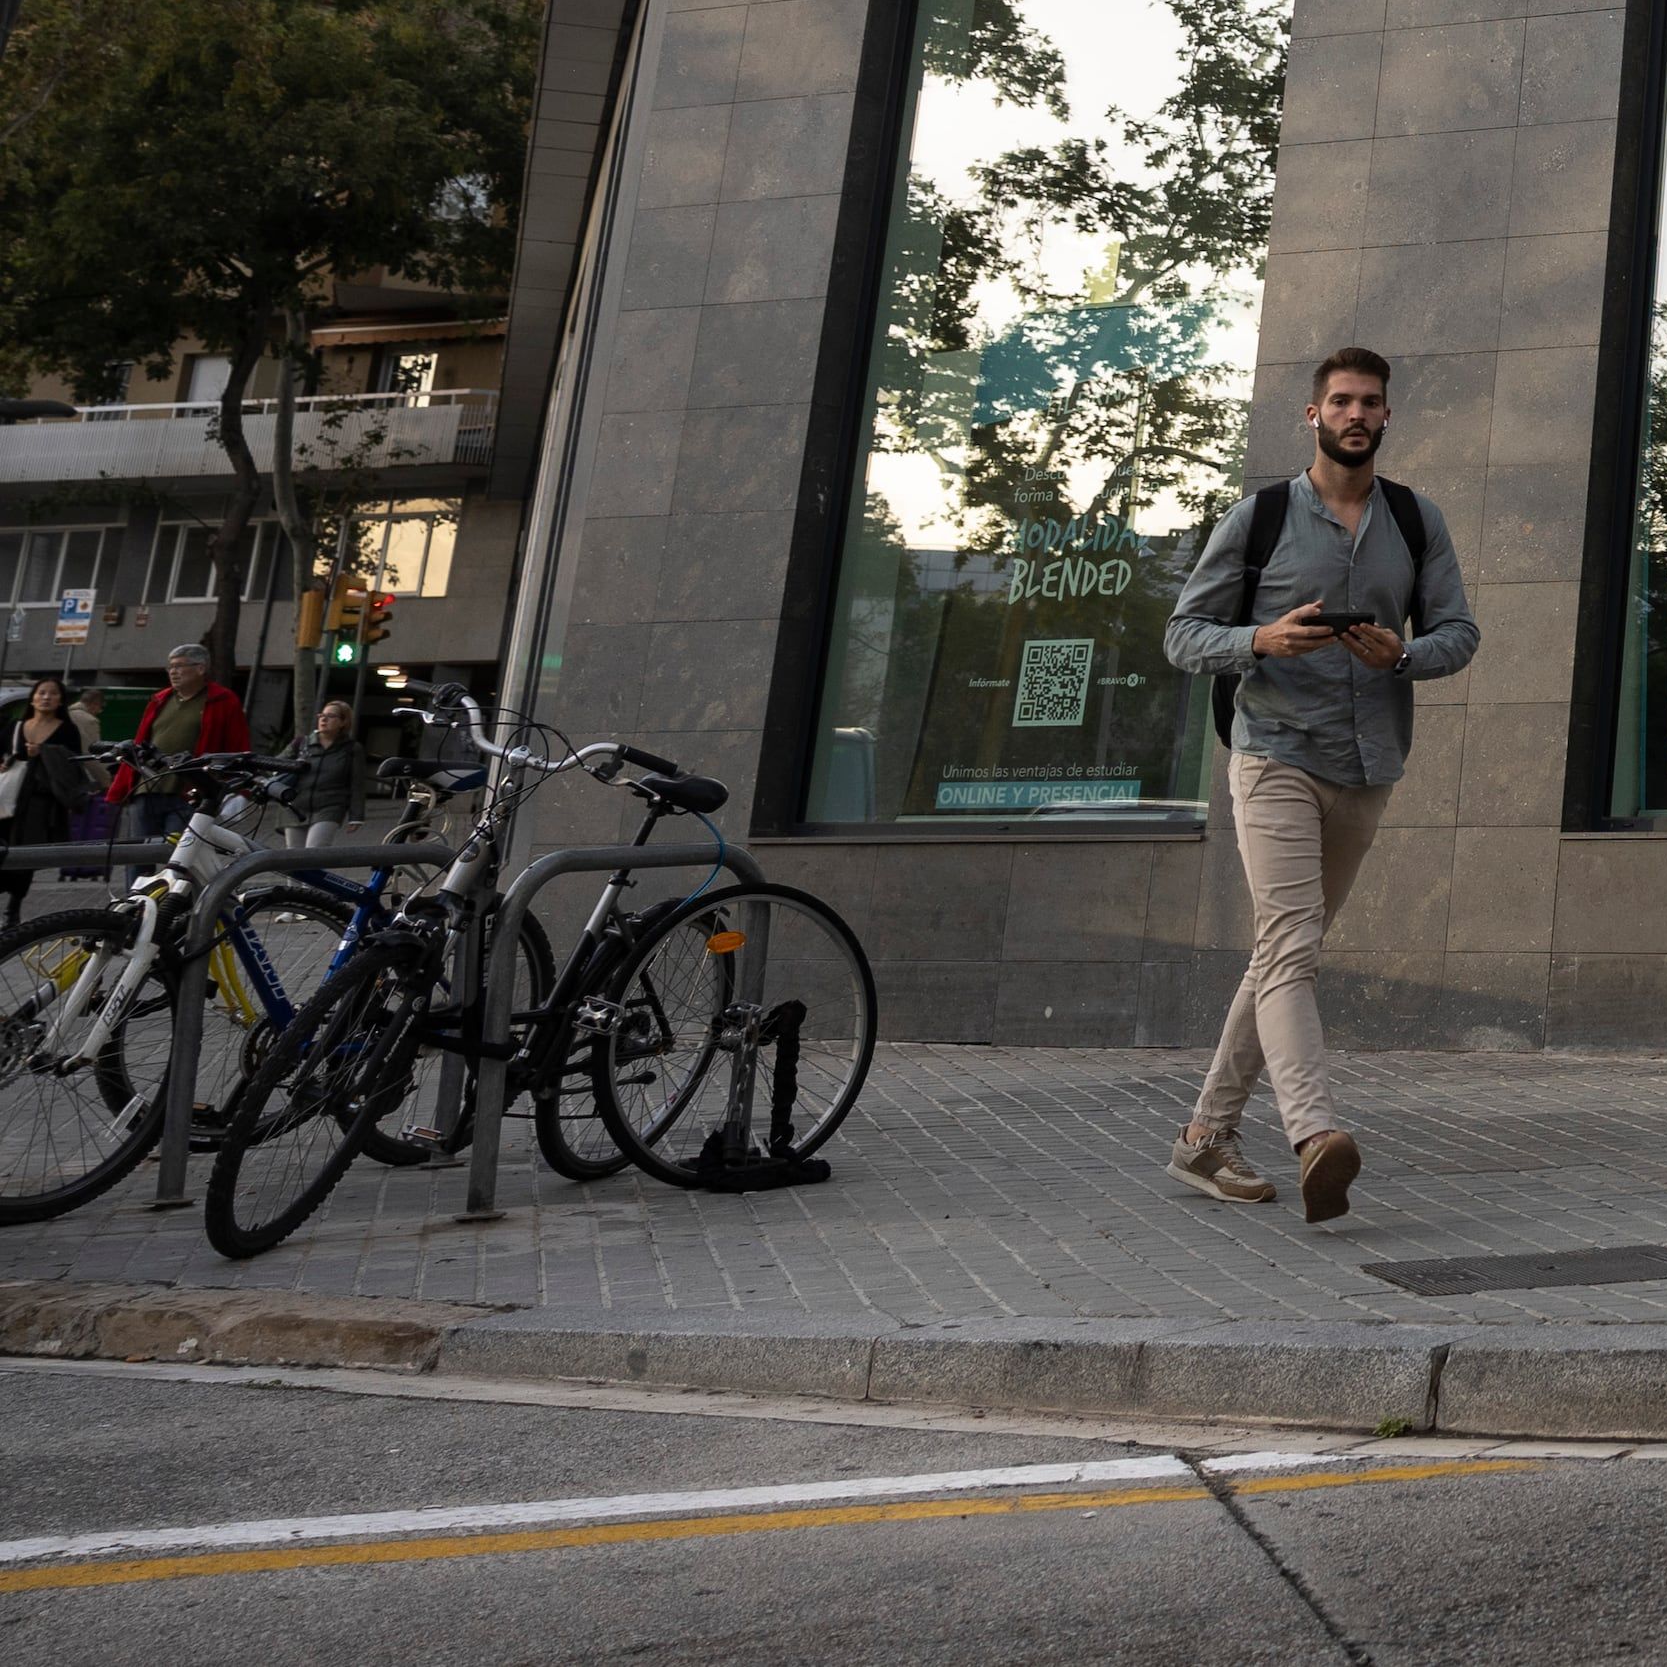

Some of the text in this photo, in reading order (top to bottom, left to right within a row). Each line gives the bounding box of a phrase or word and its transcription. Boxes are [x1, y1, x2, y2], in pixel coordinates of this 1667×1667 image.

[1014, 487, 1053, 503] forma
[1008, 557, 1132, 605] BLENDED
[968, 677, 1010, 688] Infórmate
[943, 761, 1138, 781] Unimos las ventajas de estudiar
[939, 785, 1137, 804] ONLINE Y PRESENCIAL
